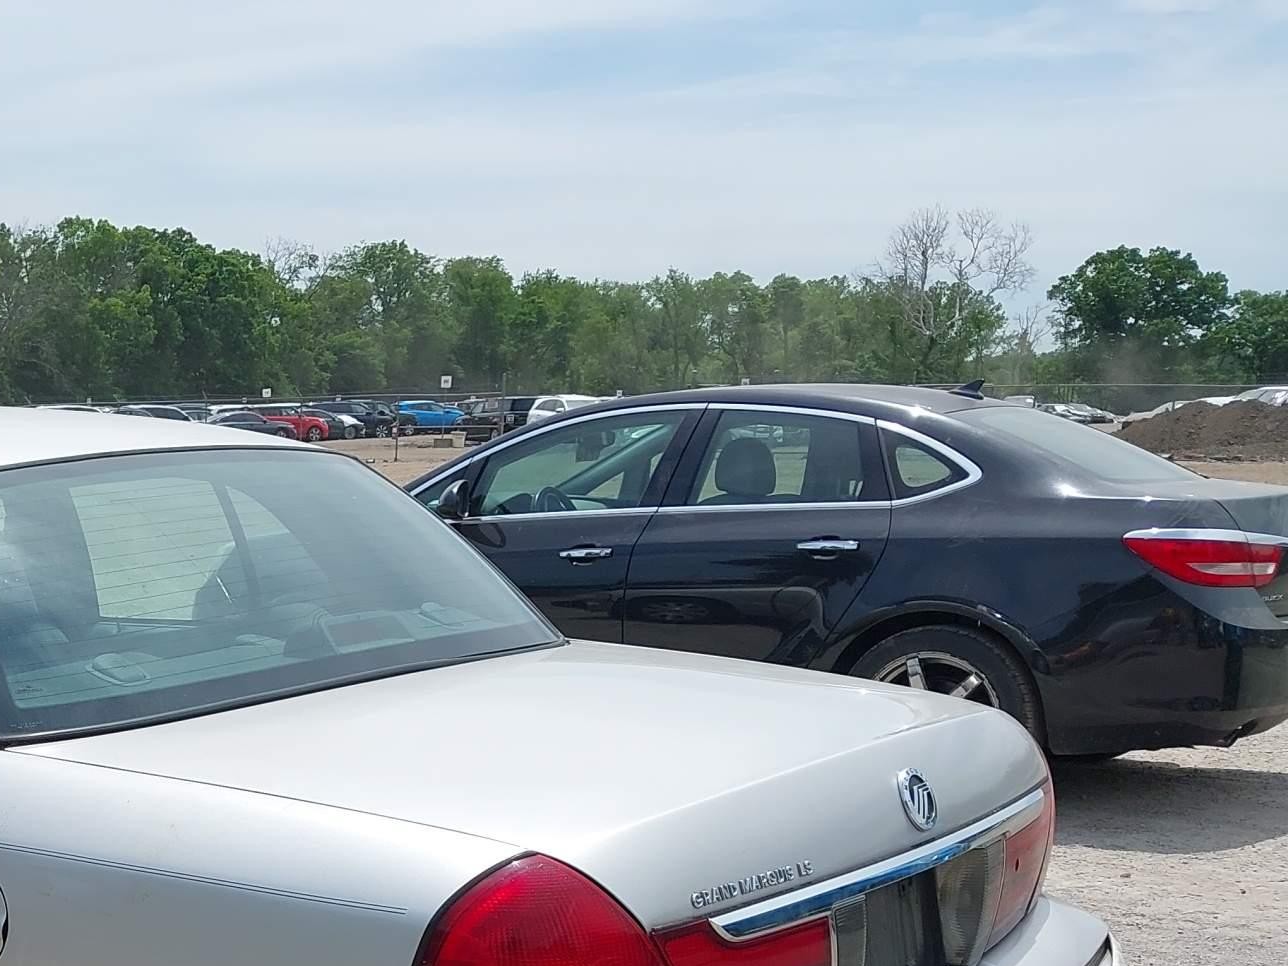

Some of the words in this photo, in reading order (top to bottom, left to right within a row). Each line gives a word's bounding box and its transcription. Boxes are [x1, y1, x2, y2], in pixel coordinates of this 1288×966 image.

[690, 881, 738, 909] GRAND
[739, 866, 794, 894] MARQUIS
[796, 860, 813, 877] LS
